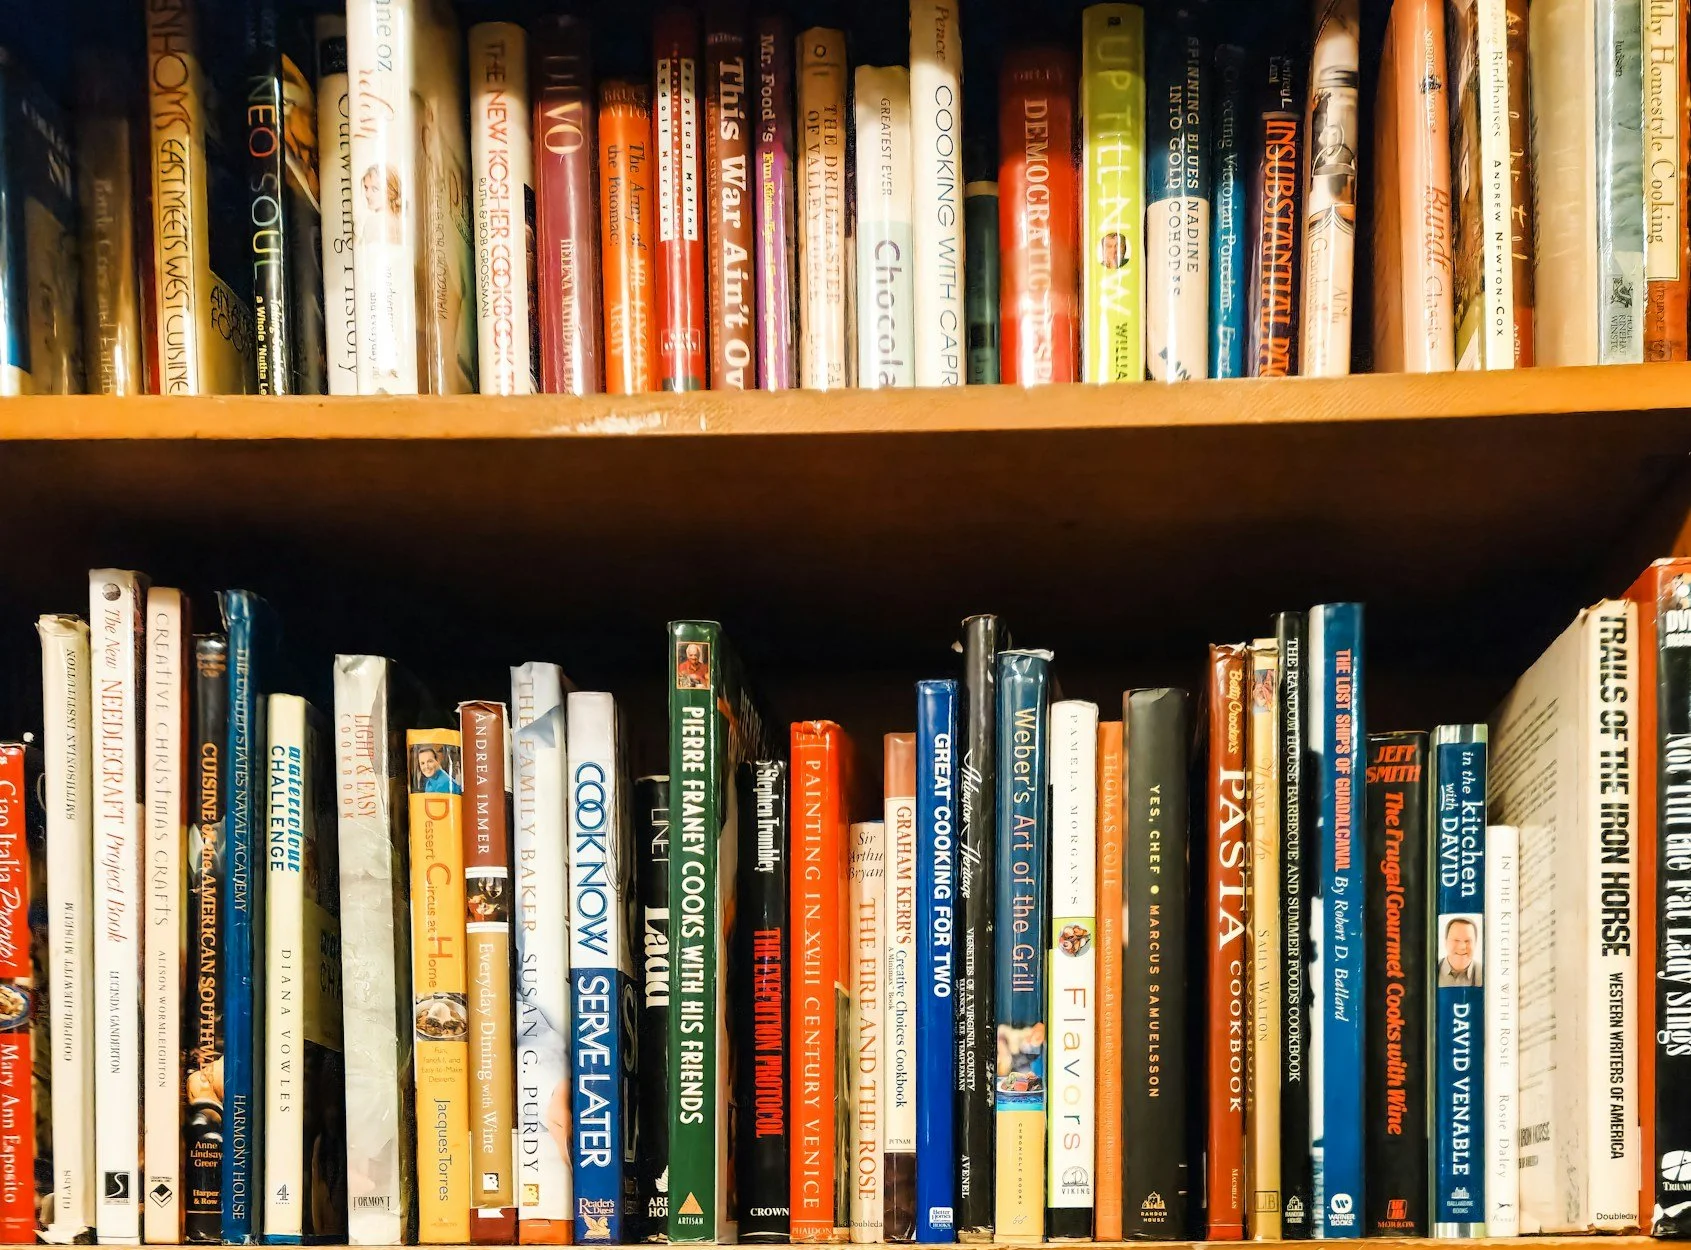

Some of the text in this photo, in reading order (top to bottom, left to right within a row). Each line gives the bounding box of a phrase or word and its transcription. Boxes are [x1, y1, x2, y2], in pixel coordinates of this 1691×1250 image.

[720, 58, 745, 141] This
[1170, 85, 1182, 189] INTO GOLD
[1188, 36, 1200, 188] SPINNING BLUES
[1649, 36, 1675, 243] Homestyle Cooking
[248, 75, 282, 278] NEO SOUL
[478, 177, 489, 318] RUTH & BOB GROSSMAN
[486, 43, 516, 365] THE NEW KOSHER COOKBOOK
[722, 154, 746, 228] War
[935, 85, 956, 301] COOKING WITH
[1187, 200, 1198, 273] NADINE
[160, 138, 194, 394] EAST MEETS WEST CUISINE
[723, 238, 747, 329] Ain't
[101, 609, 127, 943] The New NEEDLECRAFT Project Book
[269, 745, 284, 872] CHALLENGE
[474, 713, 489, 855] ANDREA IMMER
[1149, 785, 1161, 874] YES, CHEF
[1441, 783, 1458, 888] with DAVID
[1461, 752, 1483, 898] in the kitchen
[574, 761, 608, 955] COOK NOW
[680, 706, 706, 1124] PIERRE FRANEY COOKS WITH HIS FRIENDS
[933, 733, 952, 998] GREAT COOKING FOR TWO
[802, 760, 821, 1209] PAINTING IN XVIII CENTURY VENICE
[895, 806, 912, 1108] GRAHAM KERR'S Creative Choices Cookbook
[1148, 905, 1160, 1097] MARCUS SAMUELSSON
[280, 949, 291, 1113] DIANA VOWLES
[474, 943, 496, 1154] Everyday Dining with Wine
[521, 953, 539, 1172] SUSAN G. PURDY
[577, 975, 611, 1169] SERVE LATER
[1063, 987, 1086, 1150] Flavors
[1453, 1003, 1471, 1176] DAVID VENABLE
[1609, 972, 1624, 1159] WESTERN WRITERS OF AMERICA
[190, 1150, 222, 1161] Lindsay
[193, 1189, 219, 1199] Harper
[194, 1140, 218, 1150] Anne
[194, 1158, 218, 1168] Greer
[200, 1197, 218, 1206] Row
[232, 1094, 246, 1220] HARMONY HOUSE
[750, 1207, 789, 1217] CROWN
[1061, 1187, 1090, 1195] VIKING
[1597, 1212, 1638, 1220] Doubleday
[678, 1217, 704, 1225] ARTISAN
